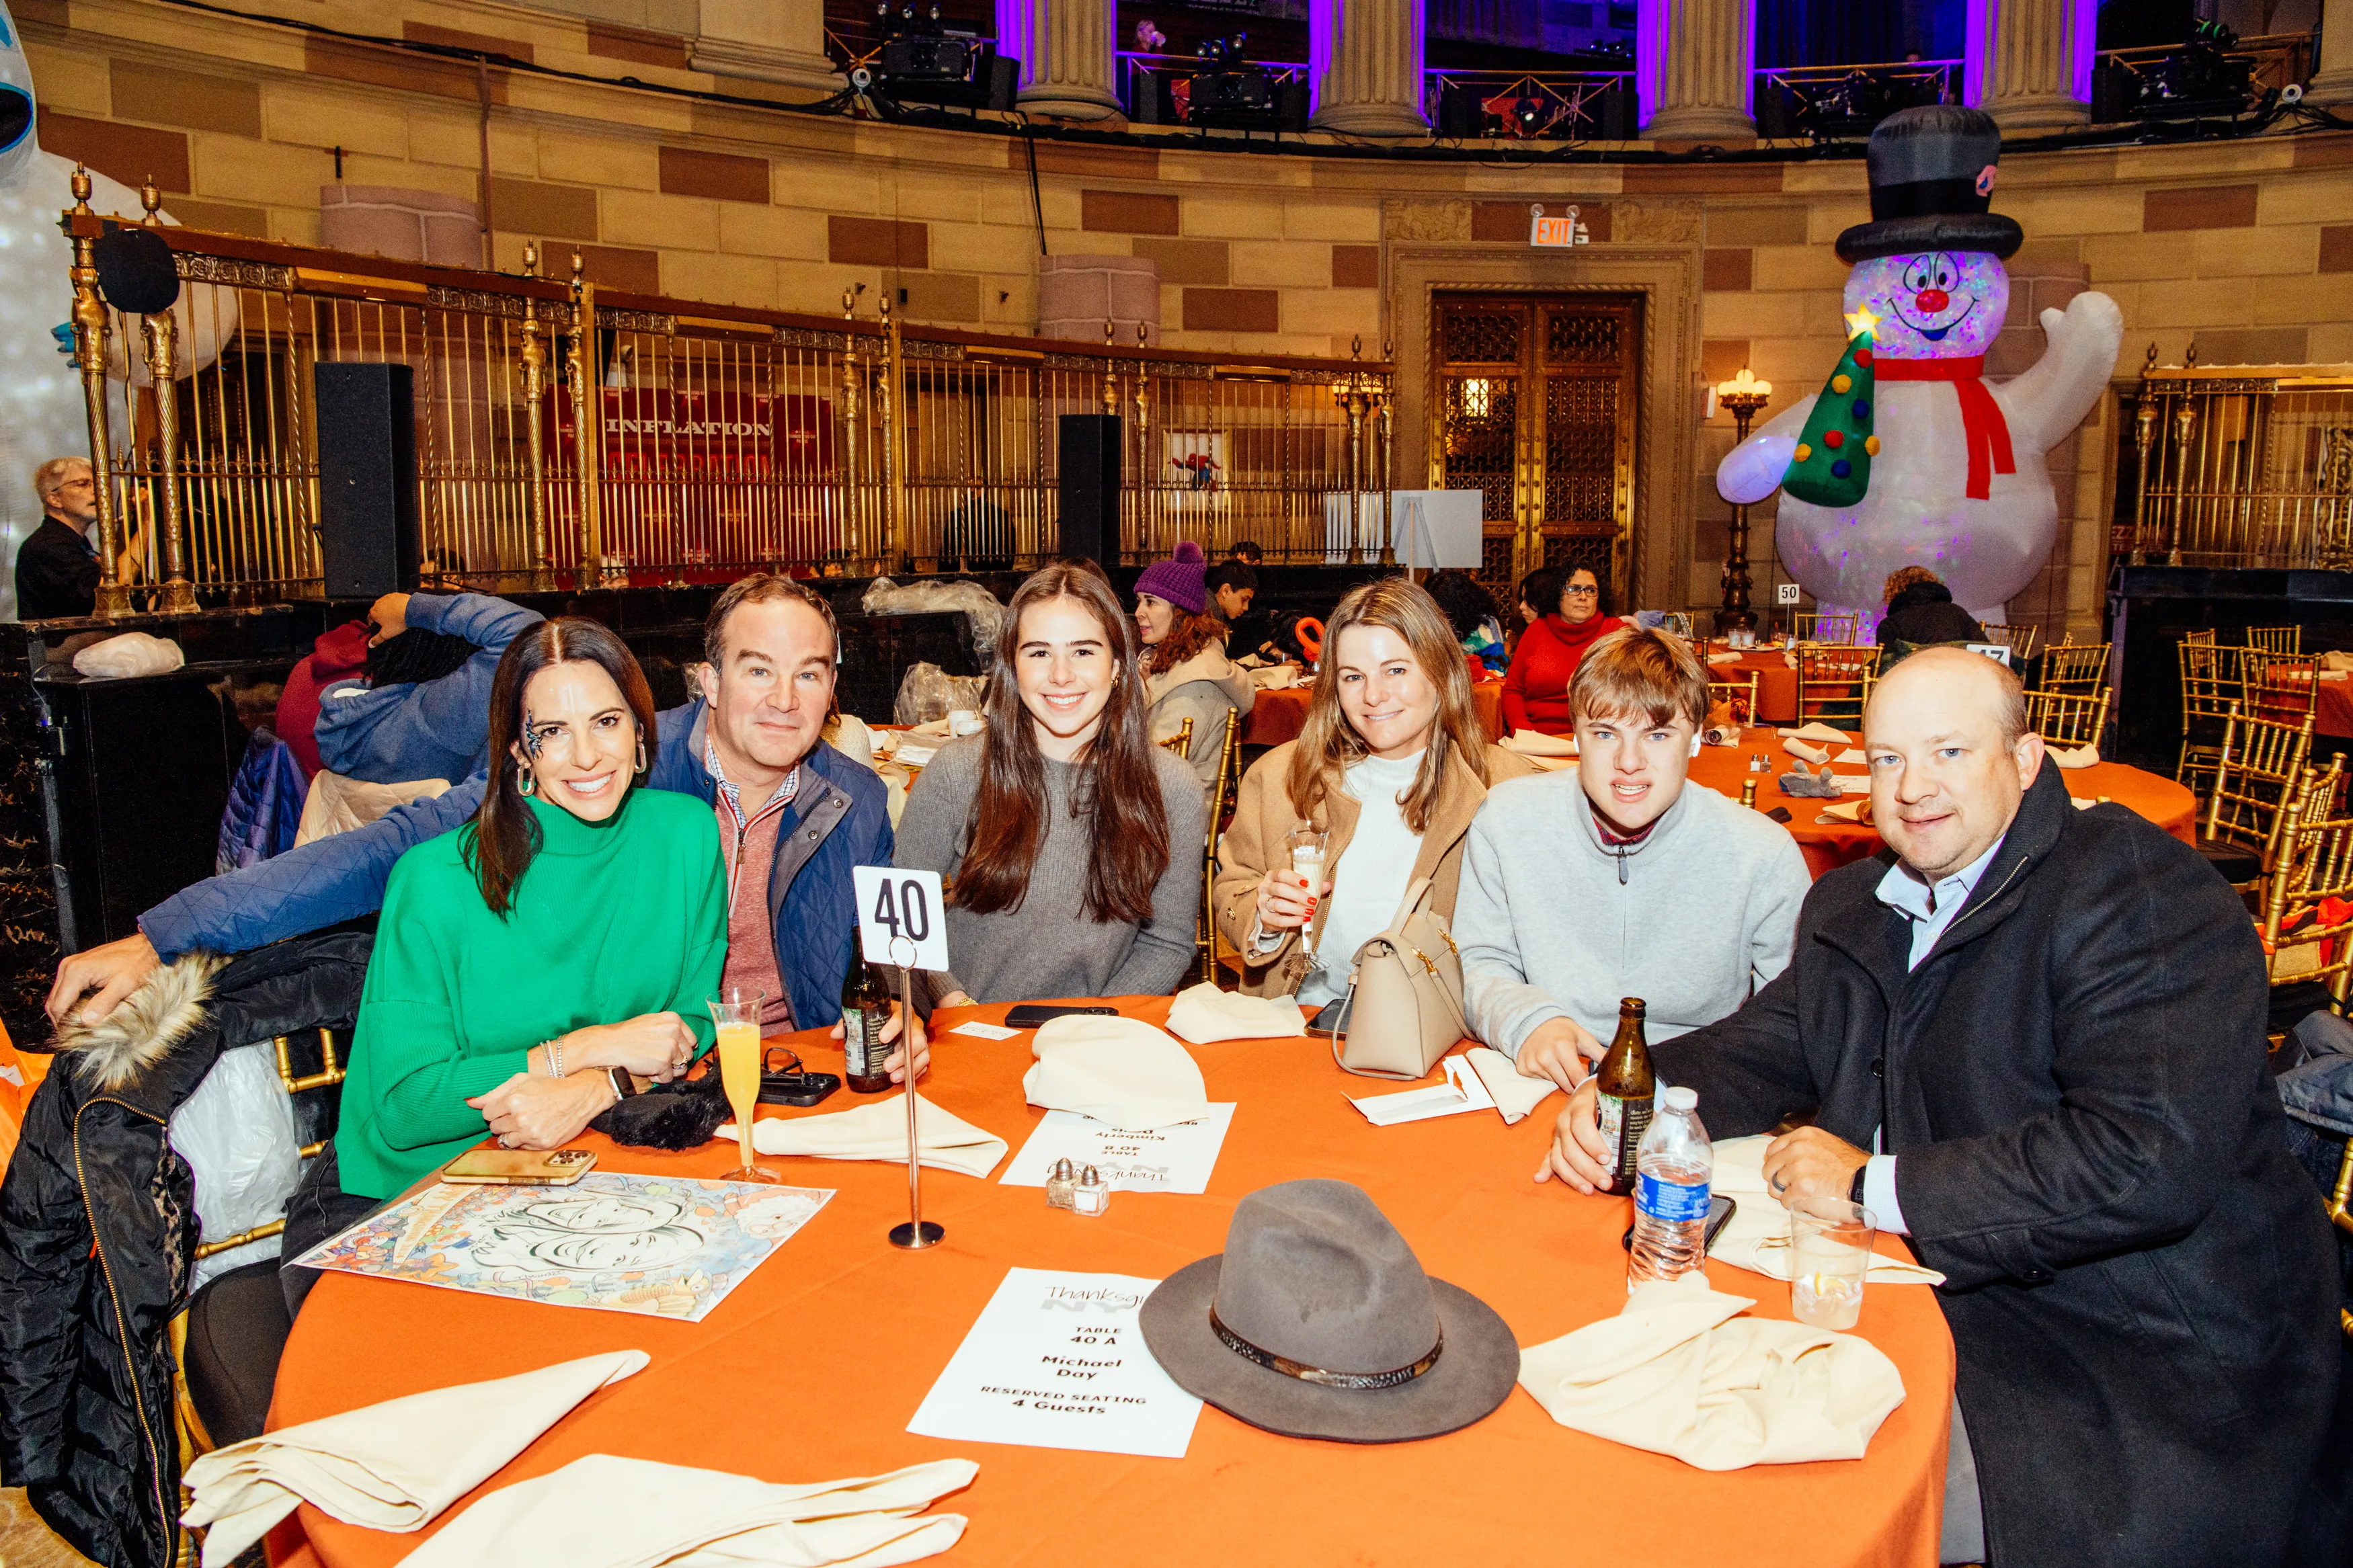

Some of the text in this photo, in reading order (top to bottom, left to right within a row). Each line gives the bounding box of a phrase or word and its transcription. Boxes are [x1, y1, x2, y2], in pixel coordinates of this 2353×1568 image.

[1536, 218, 1571, 244] EXIT
[606, 418, 771, 436] INFLATION
[1782, 586, 1797, 599] 50
[875, 878, 930, 942] 40
[1094, 1131, 1166, 1141] Kimberly
[1070, 1336, 1097, 1344] 40
[1041, 1355, 1122, 1367] Michael
[1056, 1369, 1097, 1380] Day
[980, 1386, 1147, 1405] RESERVED SEATING
[1034, 1401, 1106, 1414] Guests
